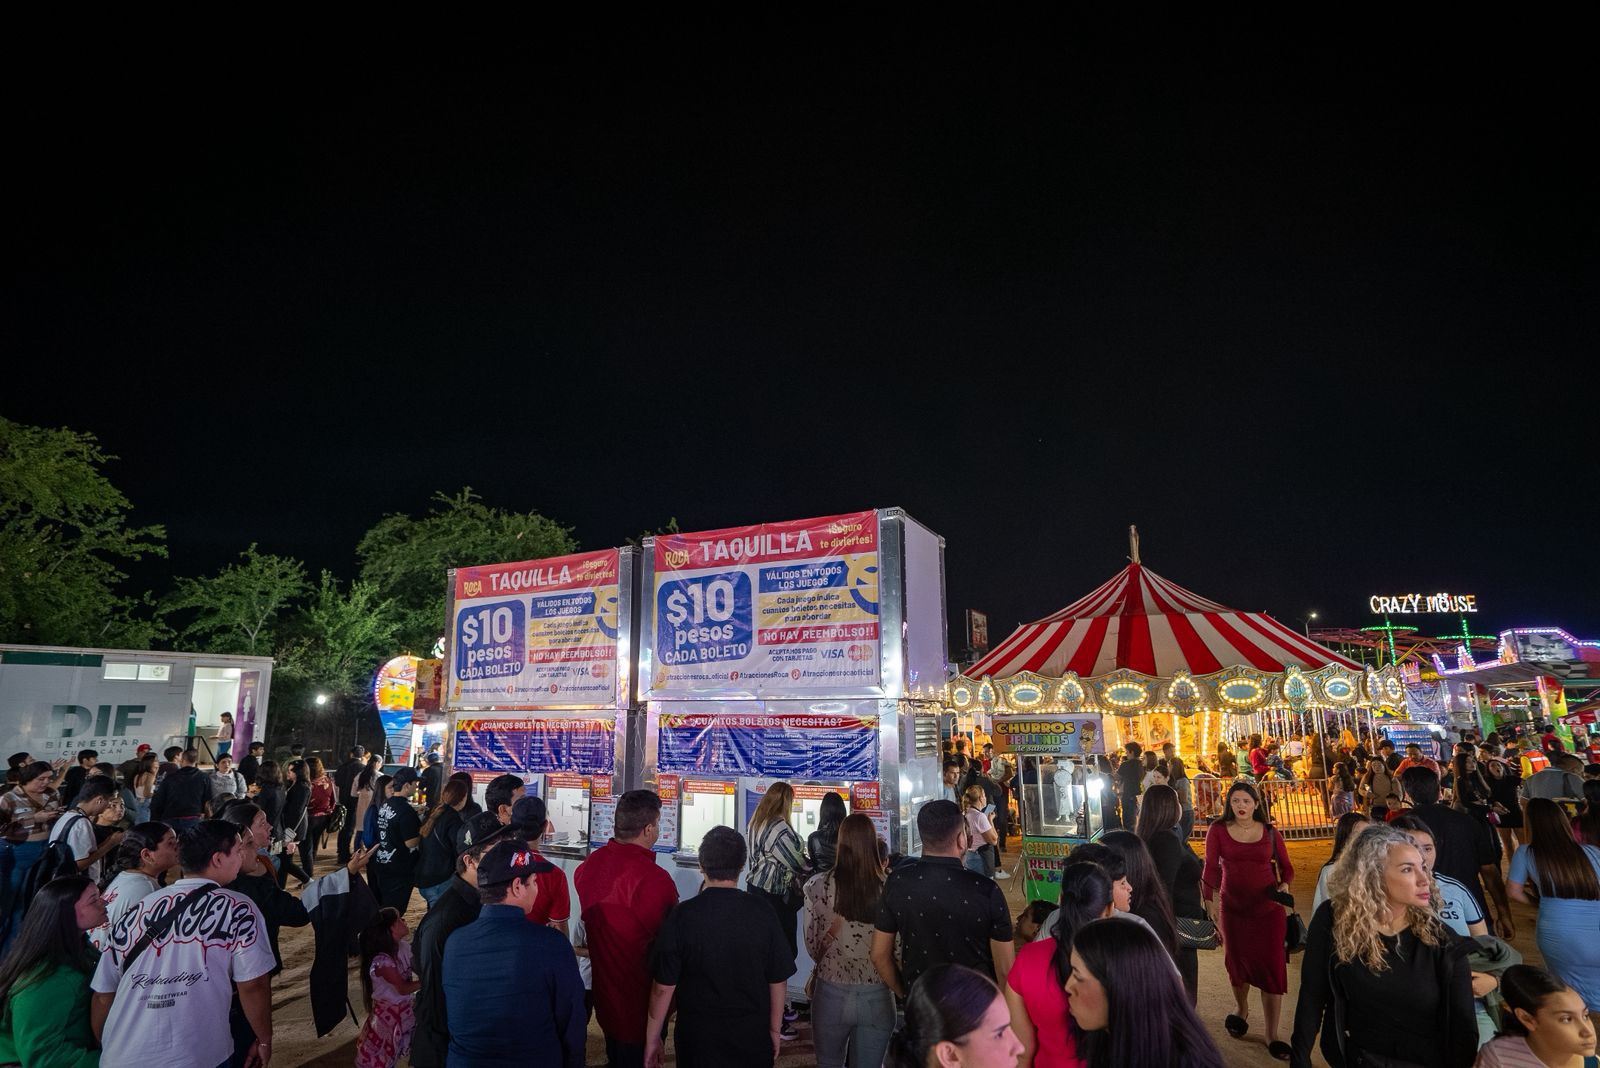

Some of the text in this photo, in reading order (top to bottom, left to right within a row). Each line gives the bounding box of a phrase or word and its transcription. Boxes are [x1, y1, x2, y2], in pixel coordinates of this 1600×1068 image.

[699, 530, 813, 562] TAQUILLA
[820, 534, 873, 549] te diviertes!
[665, 550, 690, 569] ROCA
[490, 565, 572, 591] TAQUILLA
[576, 569, 615, 581] te diviertes!
[766, 566, 842, 580] VÁLIDOS EN TODOS
[463, 580, 483, 597] ROCA
[778, 577, 829, 589] LOS JUEGOS
[537, 597, 592, 608] VÁLIDOS EN TODOS
[667, 580, 734, 627] $10
[795, 596, 816, 605] juego
[1370, 593, 1478, 614] CRAZY MOUSE
[557, 606, 582, 614] JUEGOS
[762, 607, 789, 615] cuantos
[791, 605, 818, 613] boletos
[784, 615, 801, 623] para
[462, 607, 513, 647] $10
[763, 626, 874, 640] NO HAY REEMBOLSO!!
[675, 624, 734, 650] pesos
[467, 646, 512, 667] pesos
[533, 648, 612, 660] NO HAY REEMBOLSO!!
[665, 643, 747, 663] CADA BOLETO
[820, 649, 845, 659] VISA
[460, 661, 520, 679] CADA BOLETO
[572, 668, 589, 676] VISA
[52, 704, 146, 737] DIF
[514, 721, 544, 729] BOLETOS
[740, 717, 781, 726] BOLETOS
[783, 717, 843, 726] NECESITAS?
[996, 721, 1075, 734] CHURROS
[45, 739, 140, 749] BIENESTAR
[1015, 744, 1025, 752] de
[131, 971, 204, 989] Reloading
